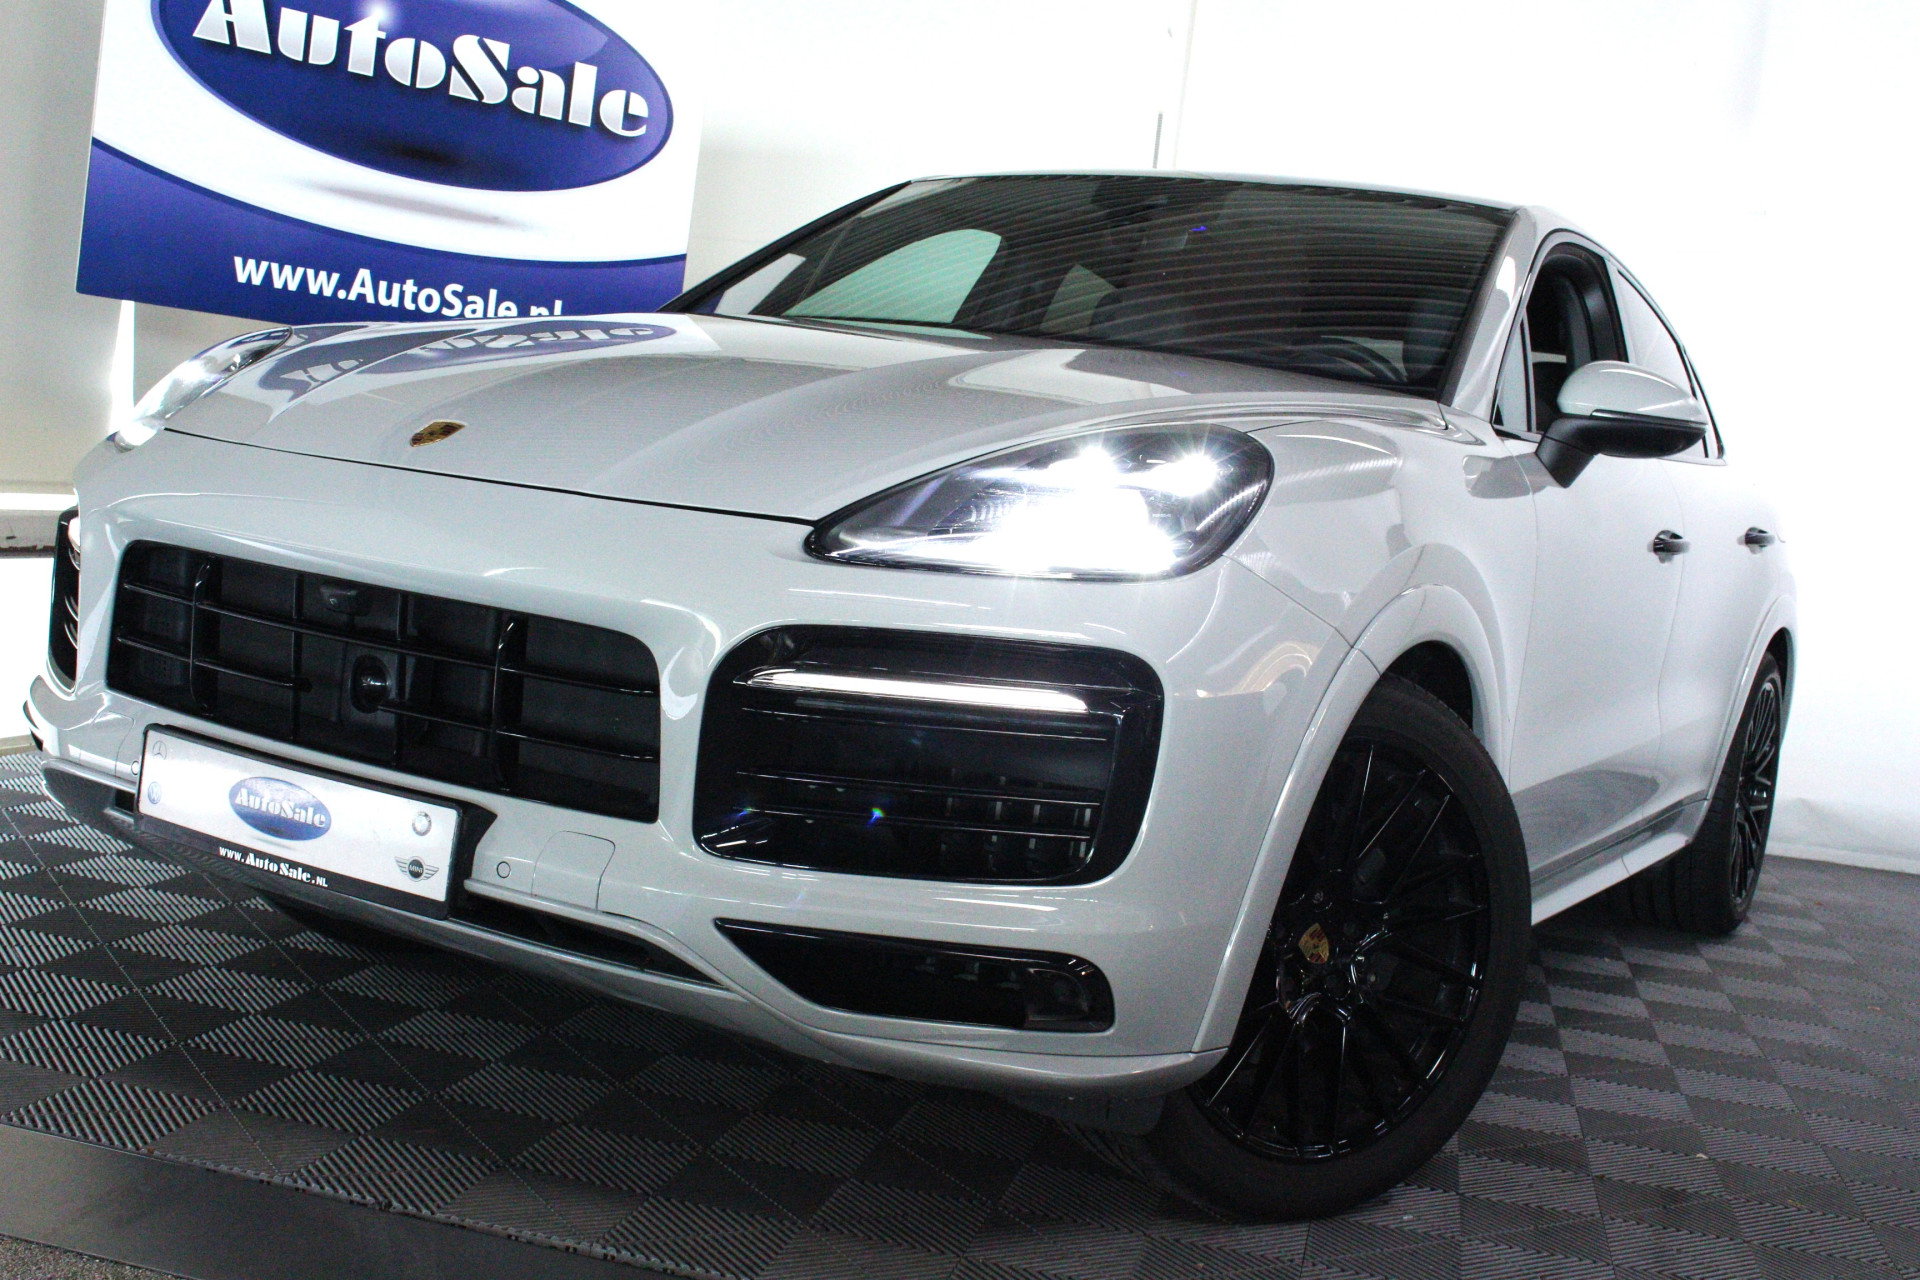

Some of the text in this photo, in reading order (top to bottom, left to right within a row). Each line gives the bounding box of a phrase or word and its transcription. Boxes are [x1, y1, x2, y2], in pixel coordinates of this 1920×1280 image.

[192, 0, 650, 138] AutoSale
[233, 255, 563, 319] www.AutoSale
[234, 787, 327, 828] AutoSale
[219, 846, 328, 888] www.AutoSale.NL
